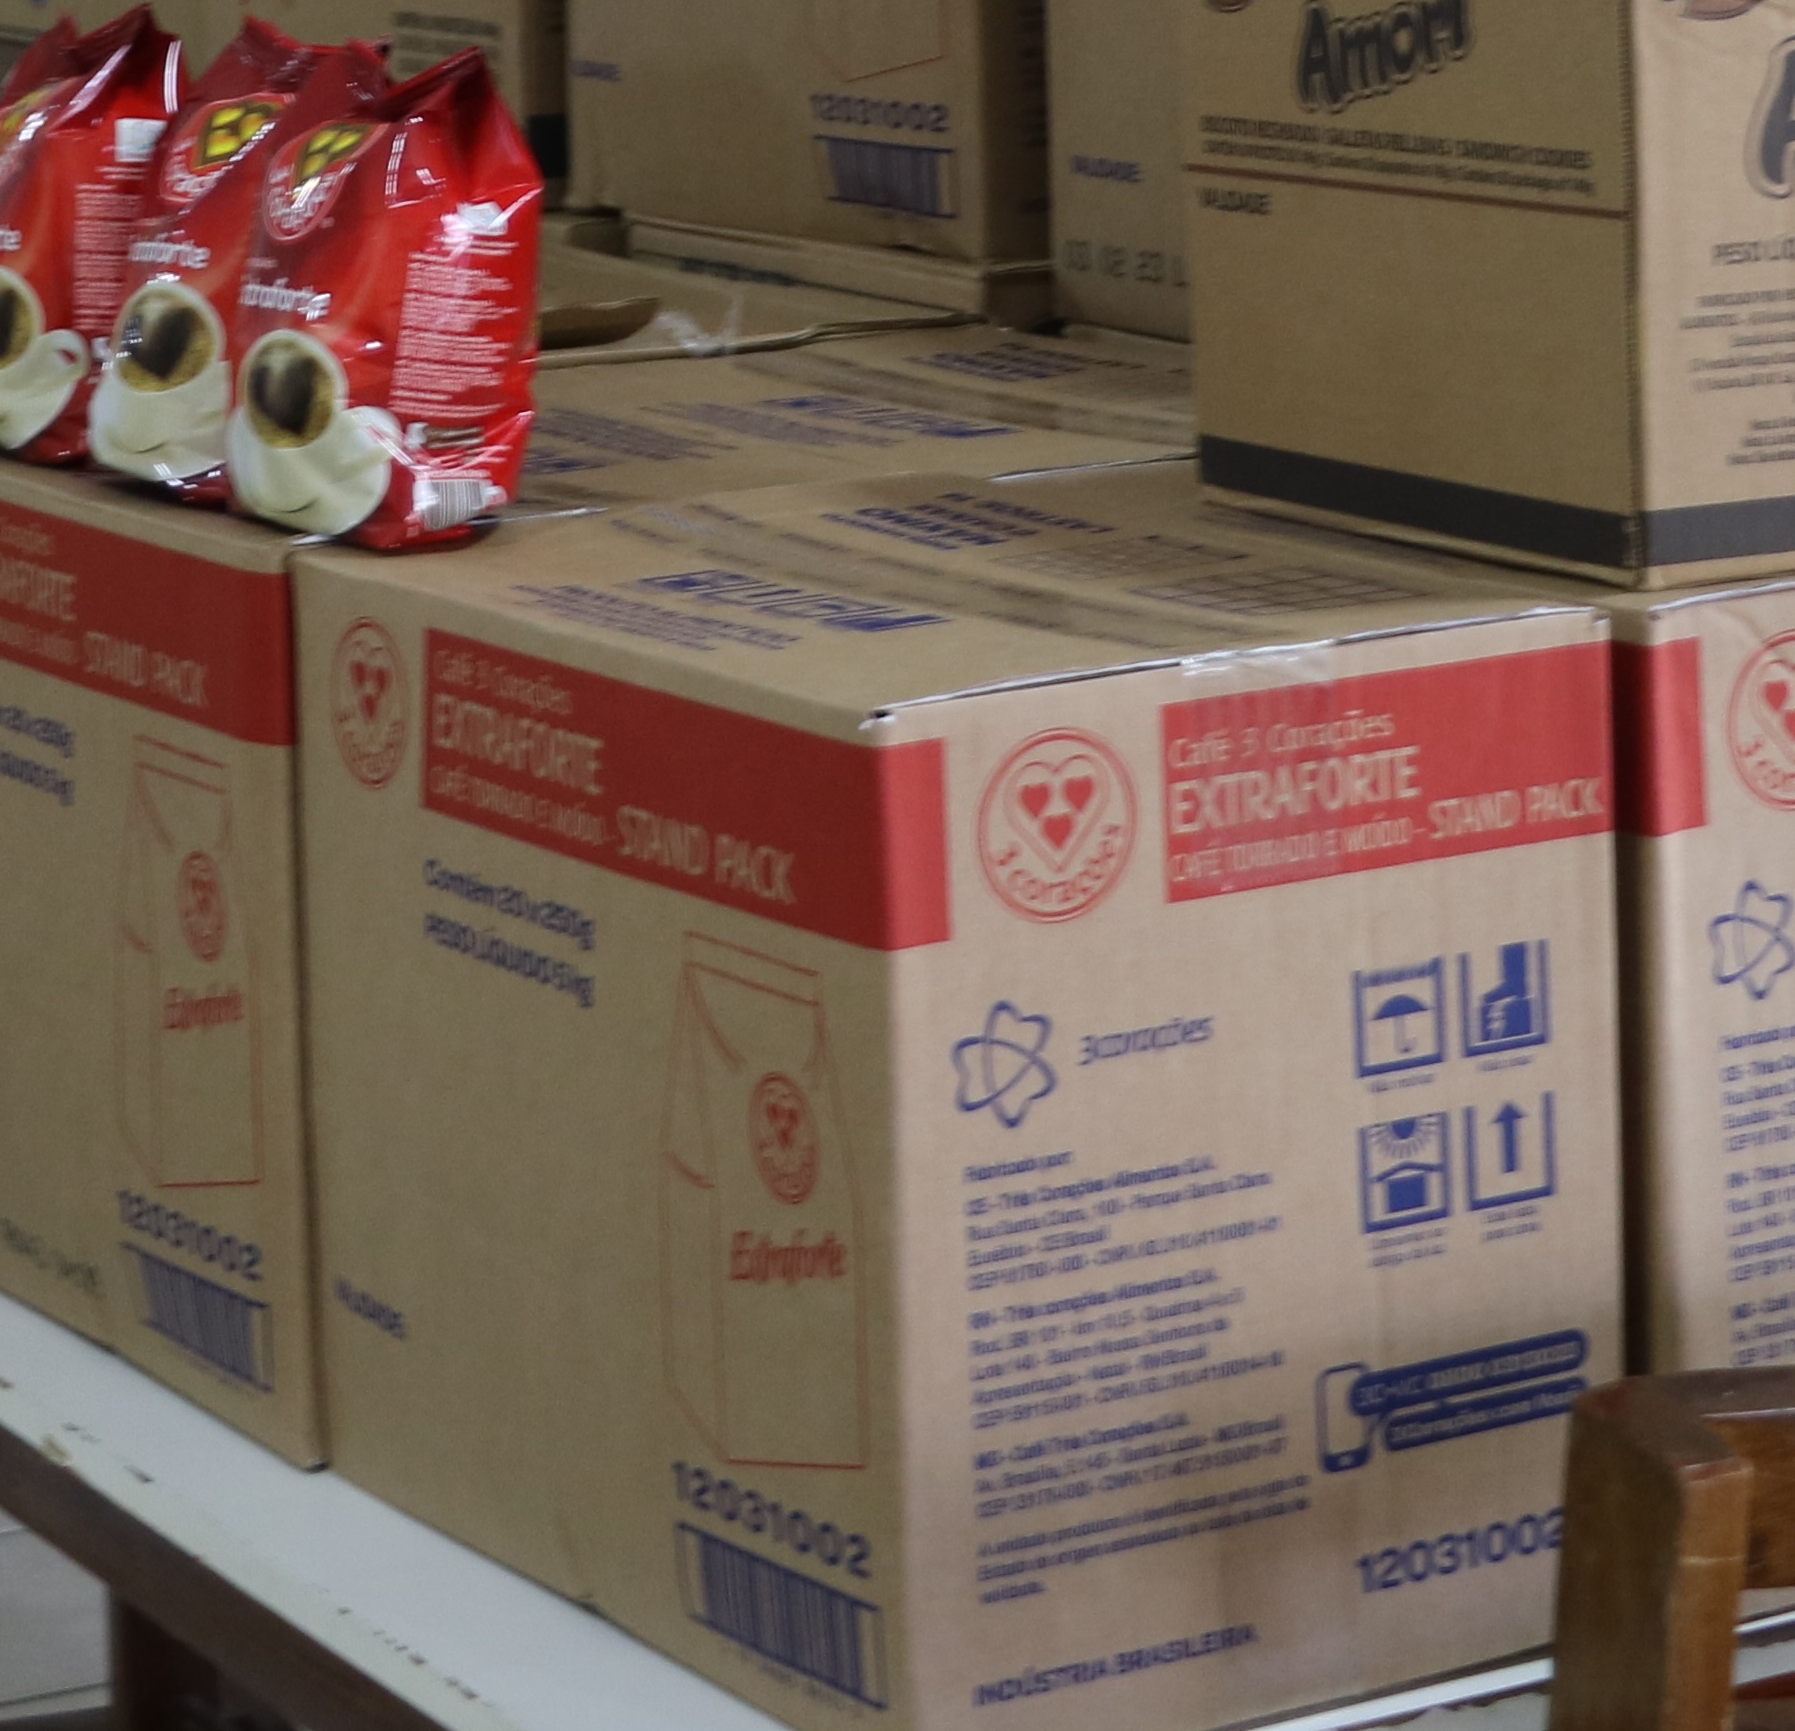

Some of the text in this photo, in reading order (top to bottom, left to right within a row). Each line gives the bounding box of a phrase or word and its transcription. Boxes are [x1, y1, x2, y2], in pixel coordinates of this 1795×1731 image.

[431, 692, 605, 796] EXTRAFORTE
[1167, 709, 1394, 768] Café 3 Corações
[1168, 745, 1422, 835] EXTRAFORTE
[1428, 789, 1523, 839] STAND
[1526, 776, 1604, 822] PACK
[615, 804, 710, 876] STAND
[714, 833, 796, 905] PACK
[116, 1189, 264, 1282] 12031002
[673, 1461, 872, 1579] 12031002
[1355, 1505, 1566, 1593] 12031002
[973, 1621, 1260, 1707] INDÚSTRIA BRASILEIRA
